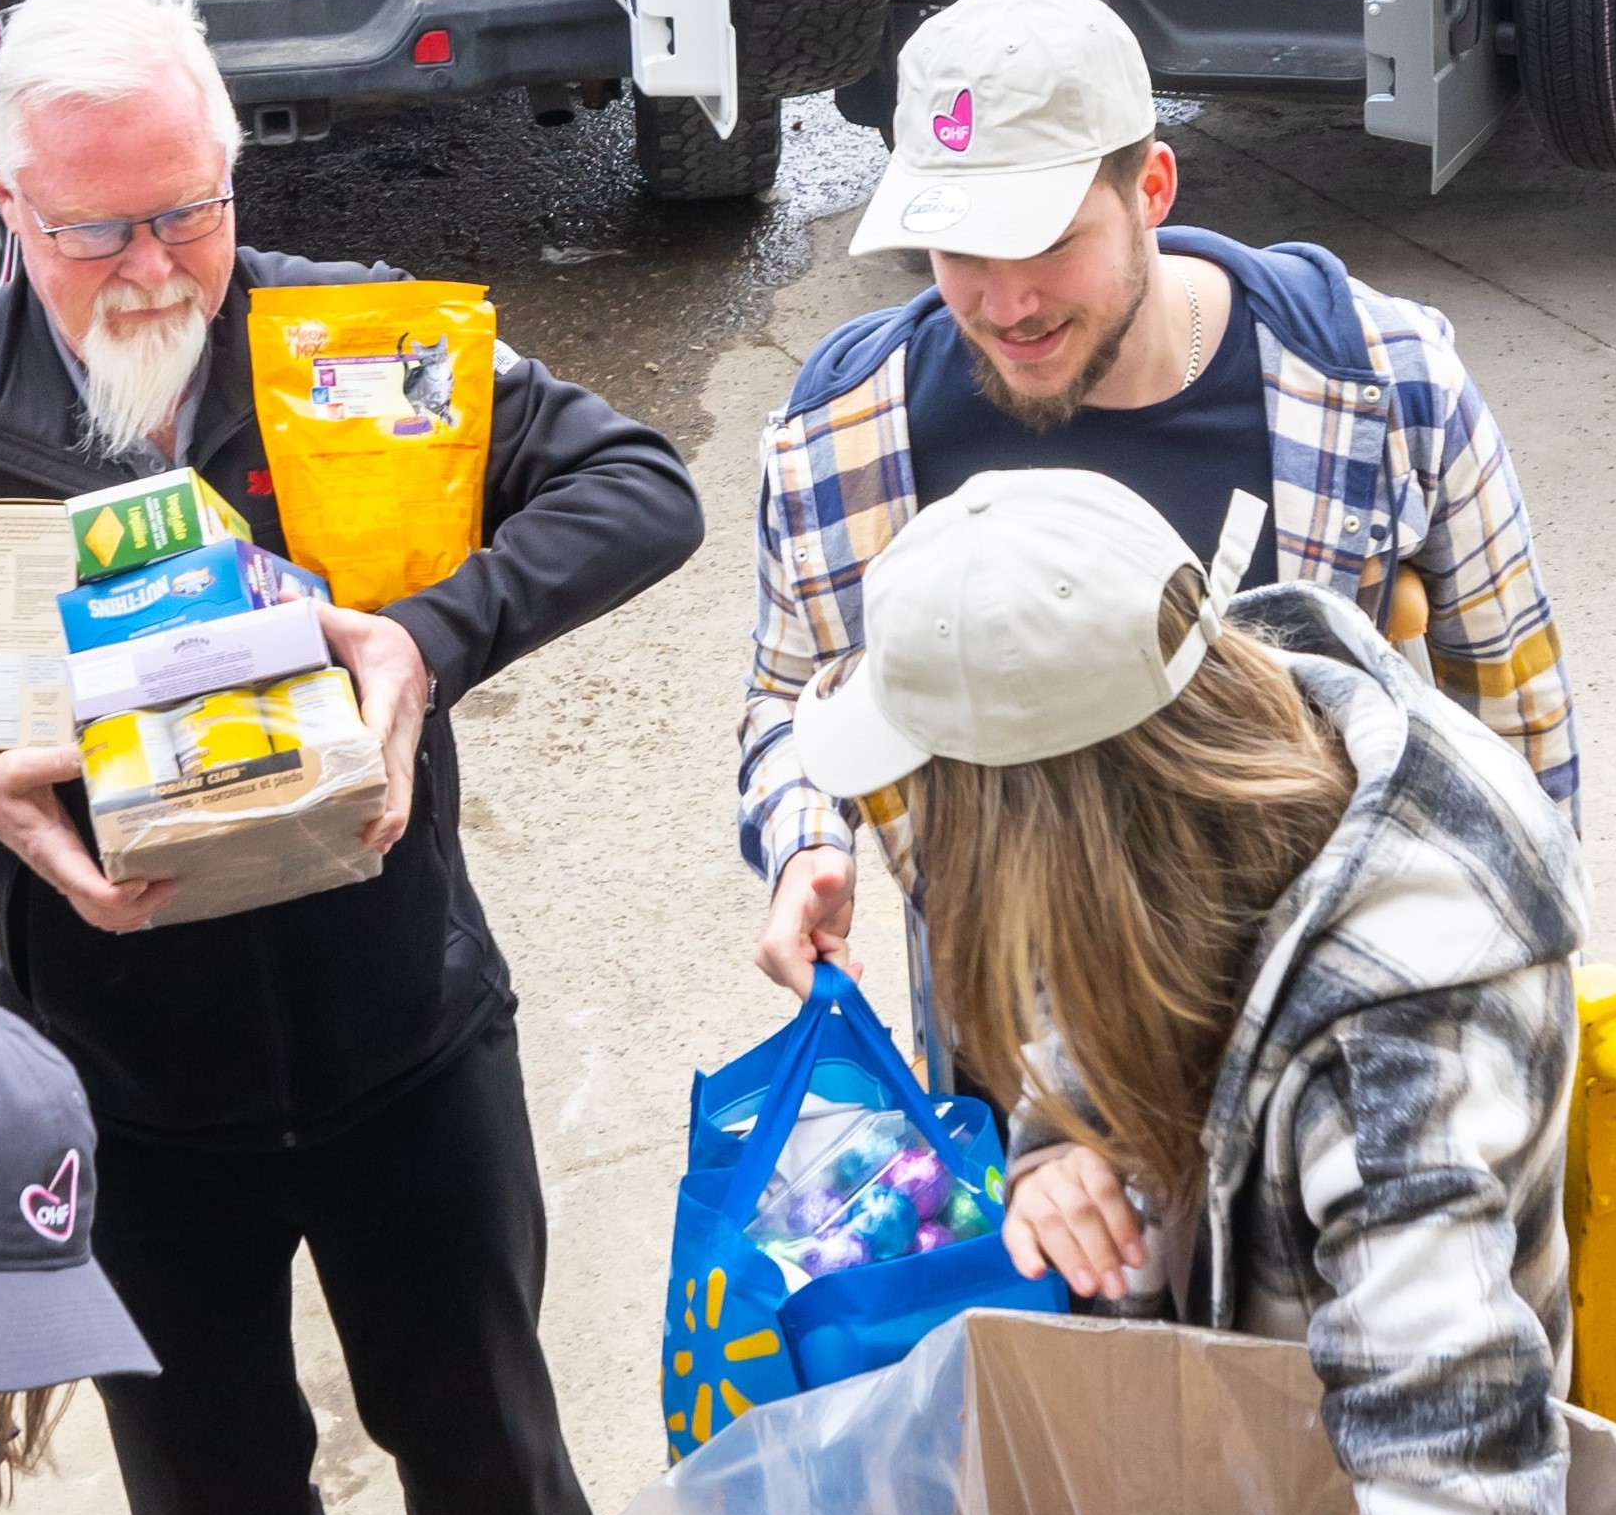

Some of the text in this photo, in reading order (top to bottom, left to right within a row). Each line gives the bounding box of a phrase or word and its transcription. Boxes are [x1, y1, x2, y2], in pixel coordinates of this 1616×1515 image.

[939, 124, 971, 142] OHF
[88, 574, 170, 619] NUT-THINS
[272, 770, 304, 792] pieds
[36, 1203, 71, 1227] OHF
